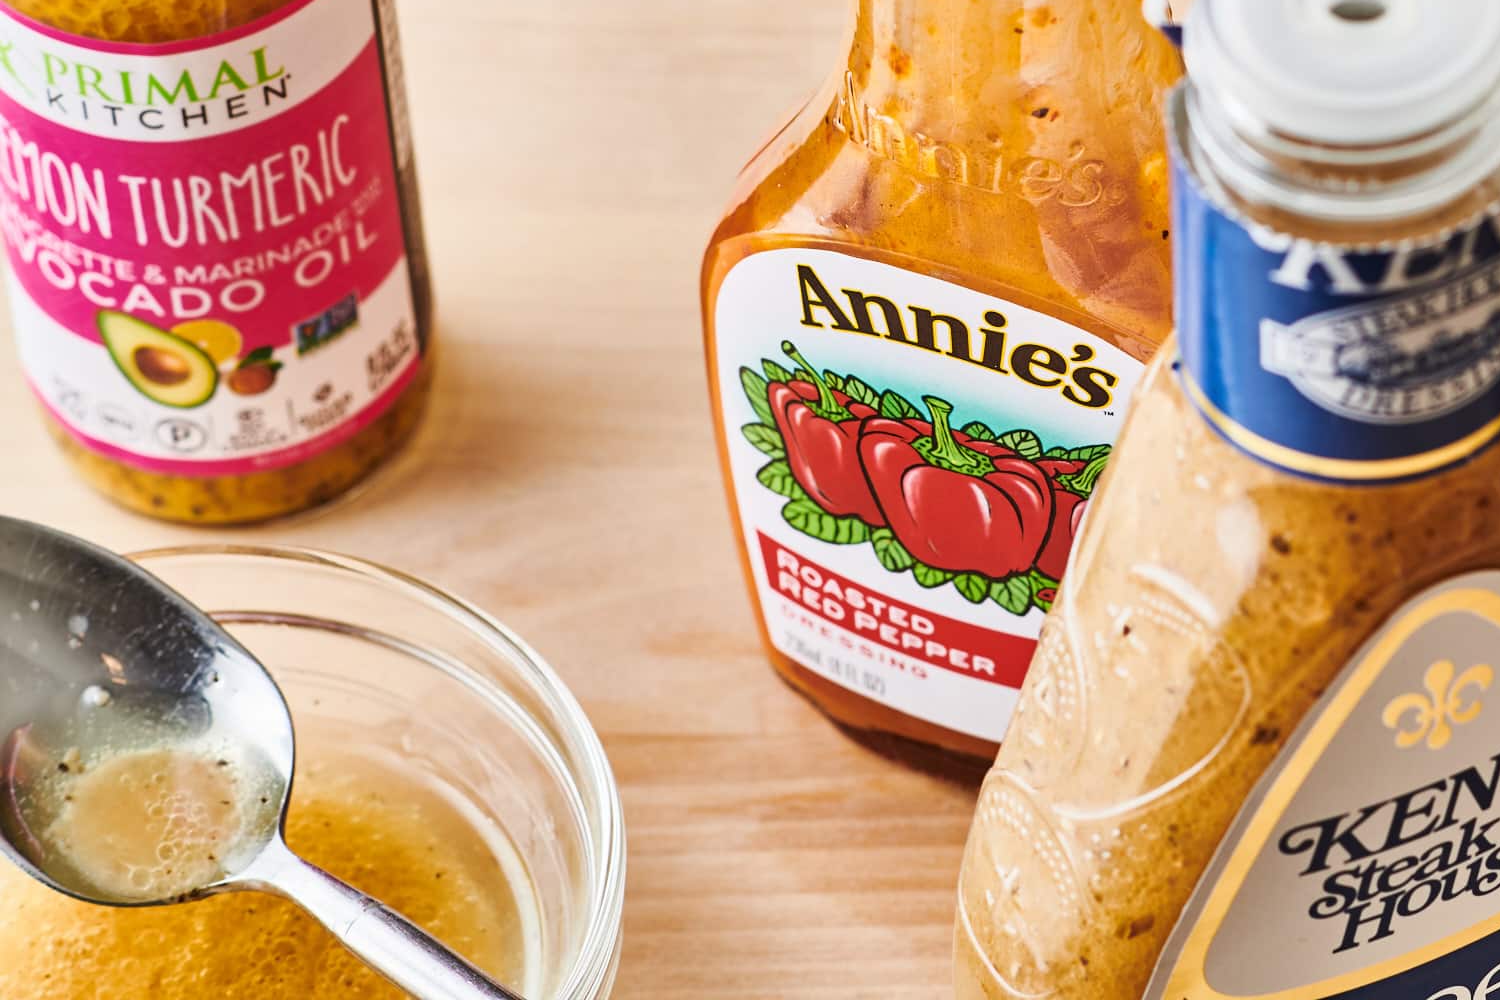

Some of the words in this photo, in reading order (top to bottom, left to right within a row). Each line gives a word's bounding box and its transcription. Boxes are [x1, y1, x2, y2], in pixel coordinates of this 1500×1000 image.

[41, 46, 286, 106] PRIMAL
[46, 78, 290, 130] KITCHEN
[0, 113, 112, 239] EMON
[118, 114, 358, 248] TURMERIC
[3, 212, 266, 318] VOCADO
[293, 220, 378, 288] OIL
[143, 265, 166, 285] &
[174, 209, 350, 285] MARINADE
[796, 263, 1120, 411] Annie's
[776, 547, 935, 636] ROASTED
[777, 570, 847, 622] RED
[853, 609, 997, 678] PEPPER
[1309, 816, 1500, 920] Steak
